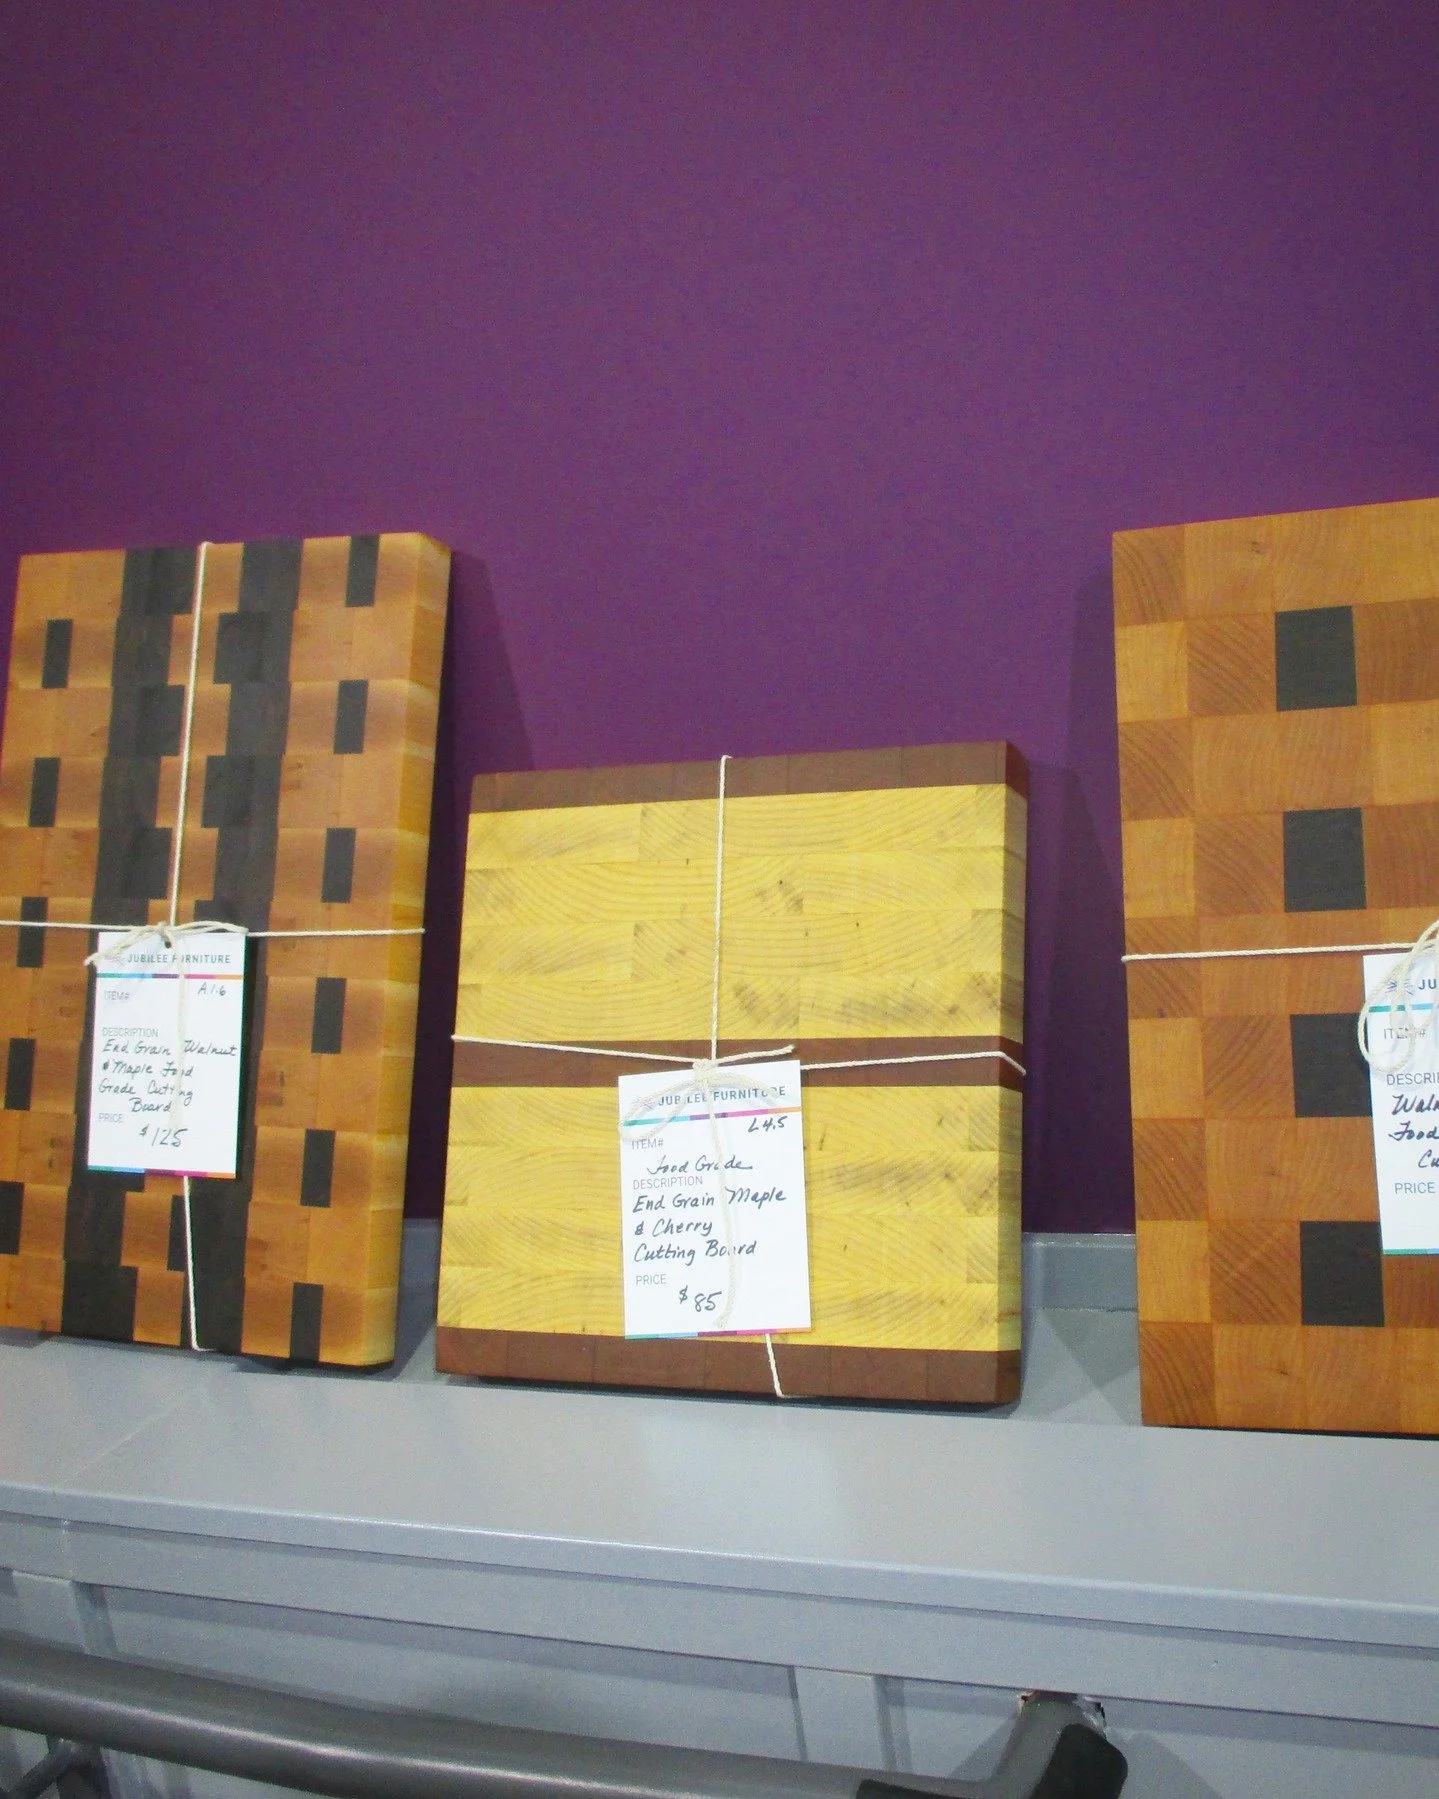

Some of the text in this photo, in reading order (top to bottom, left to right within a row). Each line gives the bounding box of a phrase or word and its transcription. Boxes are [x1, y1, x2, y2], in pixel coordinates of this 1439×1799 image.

[128, 954, 168, 964] JUBILEE
[104, 990, 130, 1001] ITEM#
[102, 1027, 159, 1038] DESCRIPTION
[103, 1039, 237, 1056] End Grain Walnut
[112, 1059, 153, 1079] Maple
[99, 1078, 136, 1095] Grade
[129, 1097, 172, 1112] Board
[99, 1113, 123, 1123] PRICE
[631, 1138, 664, 1150] ITEM#
[633, 1176, 703, 1190] DESCRIPTION
[1394, 1182, 1436, 1194] PRICE
[632, 1186, 787, 1213] End Grain Maple
[652, 1218, 713, 1238] Cherry
[634, 1243, 696, 1267] Cutting
[635, 1274, 667, 1286] PRICE
